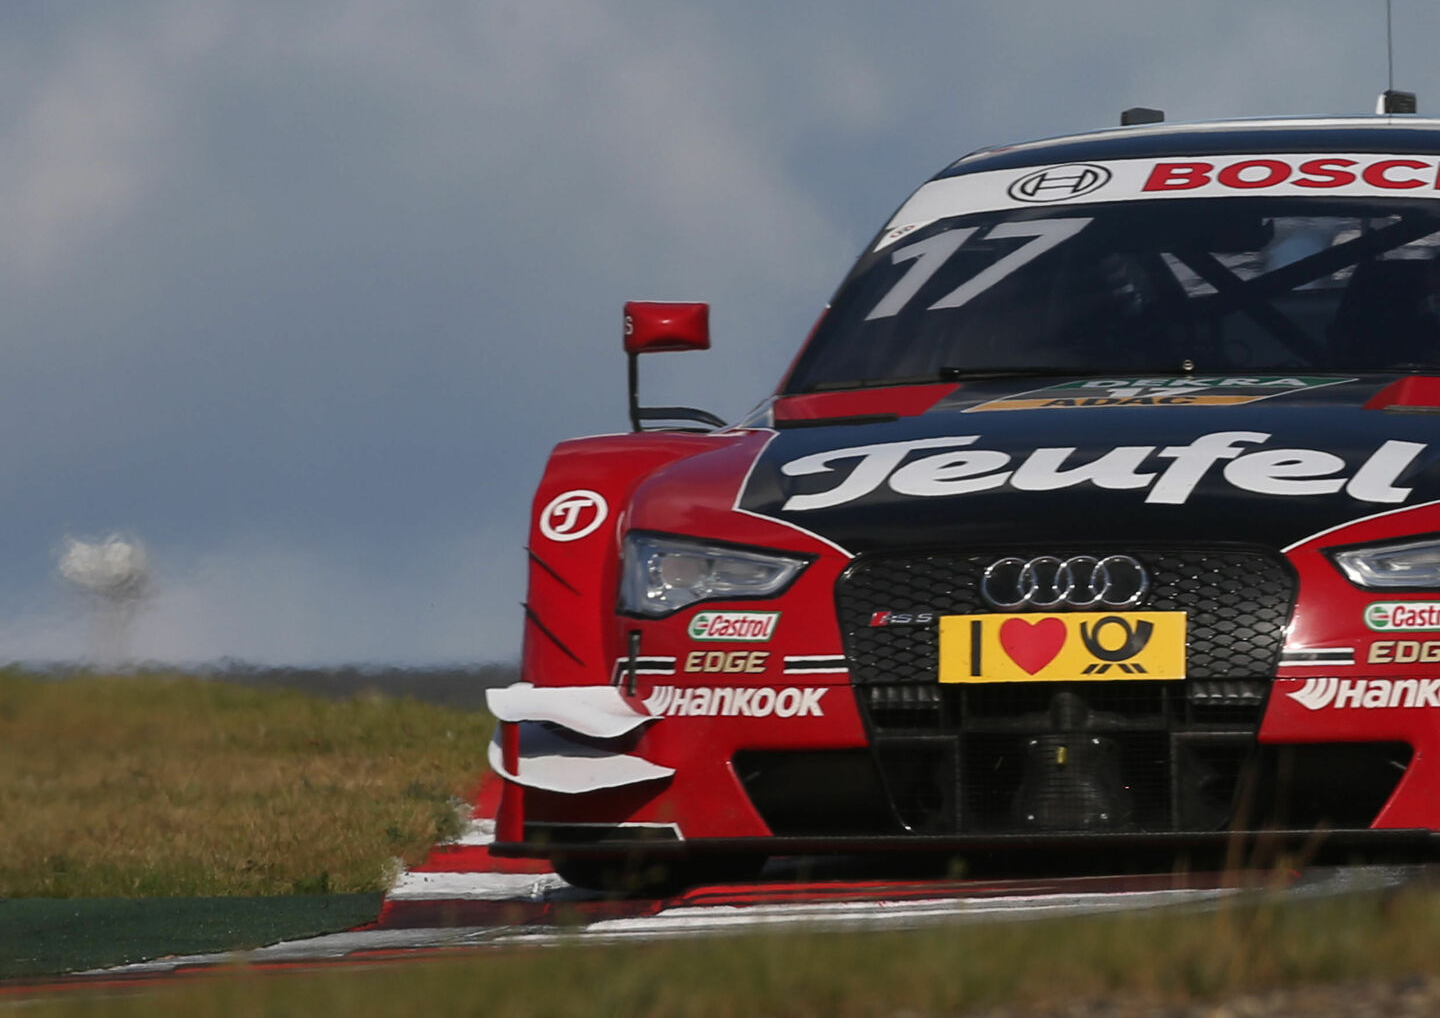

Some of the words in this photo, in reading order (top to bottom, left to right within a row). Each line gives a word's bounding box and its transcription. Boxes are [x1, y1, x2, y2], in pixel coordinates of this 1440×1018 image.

[864, 217, 1095, 321] 17
[1080, 377, 1308, 388] DEKRA
[1041, 396, 1196, 407] ADAC
[781, 431, 1428, 511] Teufel
[708, 614, 774, 638] Castrol
[683, 650, 772, 674] EDGE
